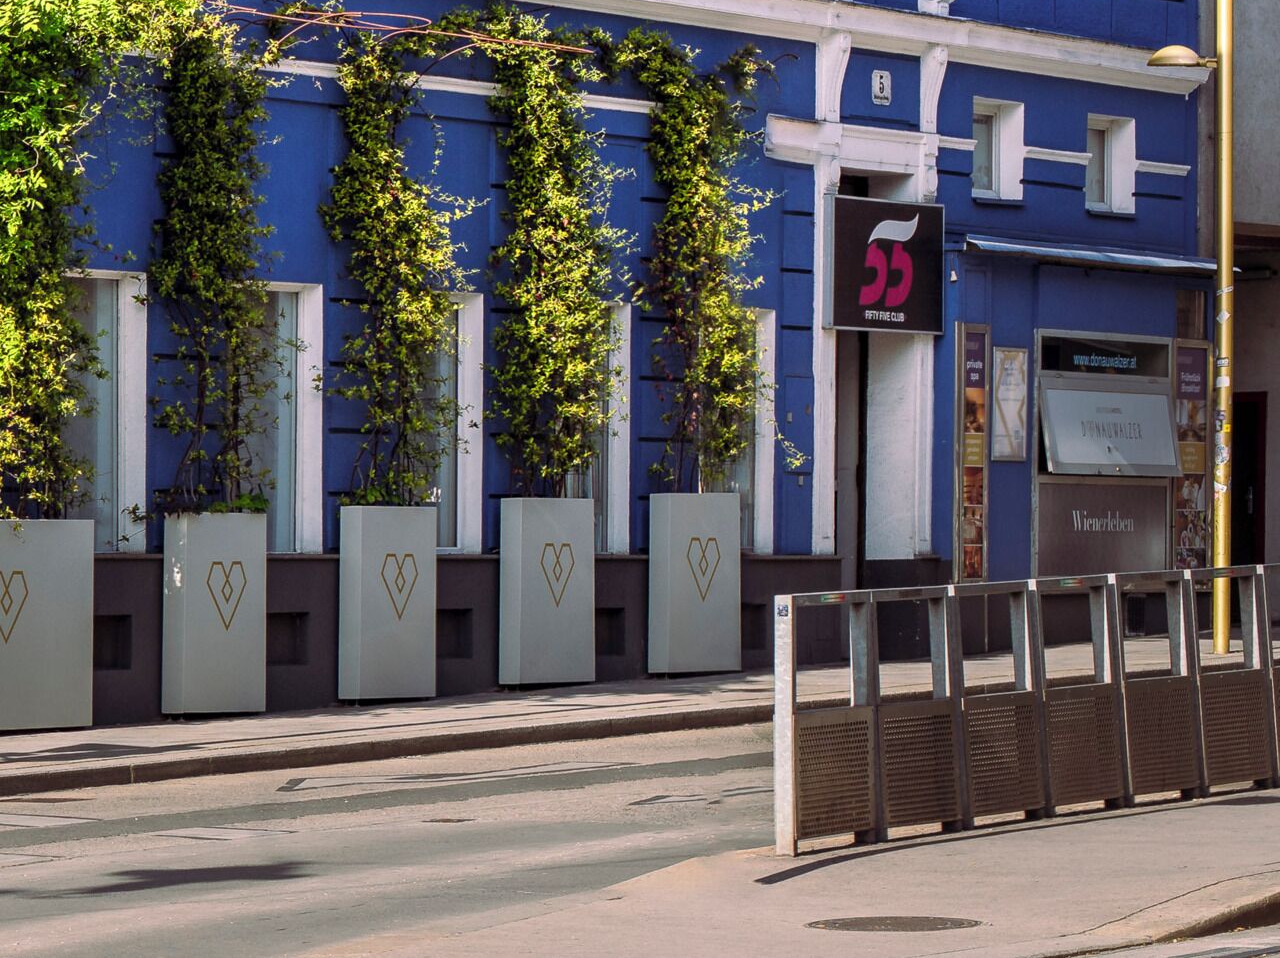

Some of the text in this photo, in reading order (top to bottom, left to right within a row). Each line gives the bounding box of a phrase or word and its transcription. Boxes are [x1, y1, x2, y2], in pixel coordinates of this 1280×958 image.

[879, 74, 885, 94] 5
[865, 310, 905, 322] FIFTY FIVE CLUB
[966, 359, 983, 370] private
[970, 372, 980, 382] spa
[1072, 509, 1134, 532] Wienerleben
